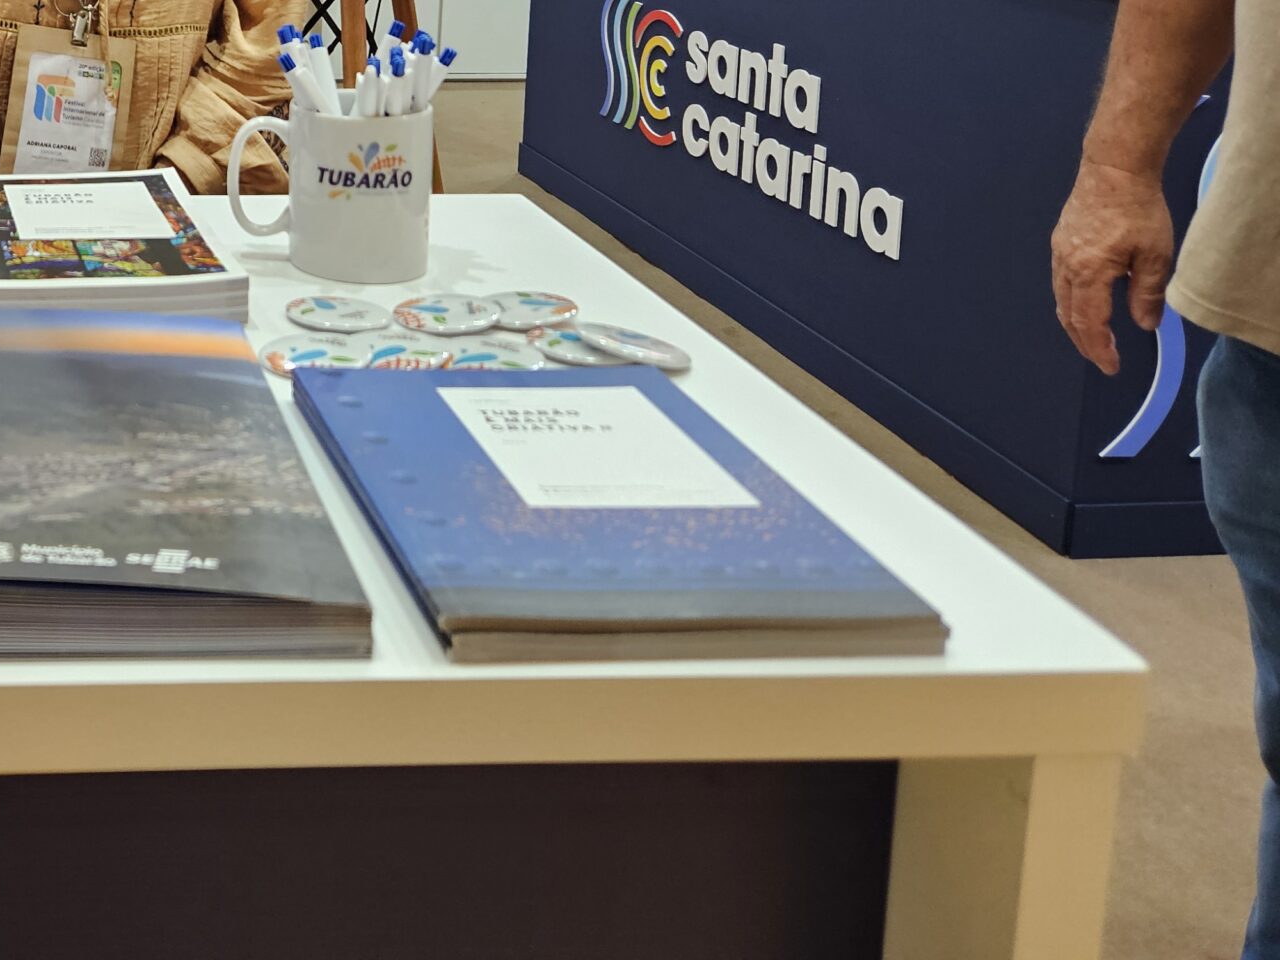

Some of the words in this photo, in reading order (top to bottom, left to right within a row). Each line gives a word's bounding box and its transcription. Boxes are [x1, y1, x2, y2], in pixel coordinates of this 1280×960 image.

[685, 30, 821, 134] santa
[317, 166, 413, 189] TUBARÃO
[682, 103, 904, 260] catarina
